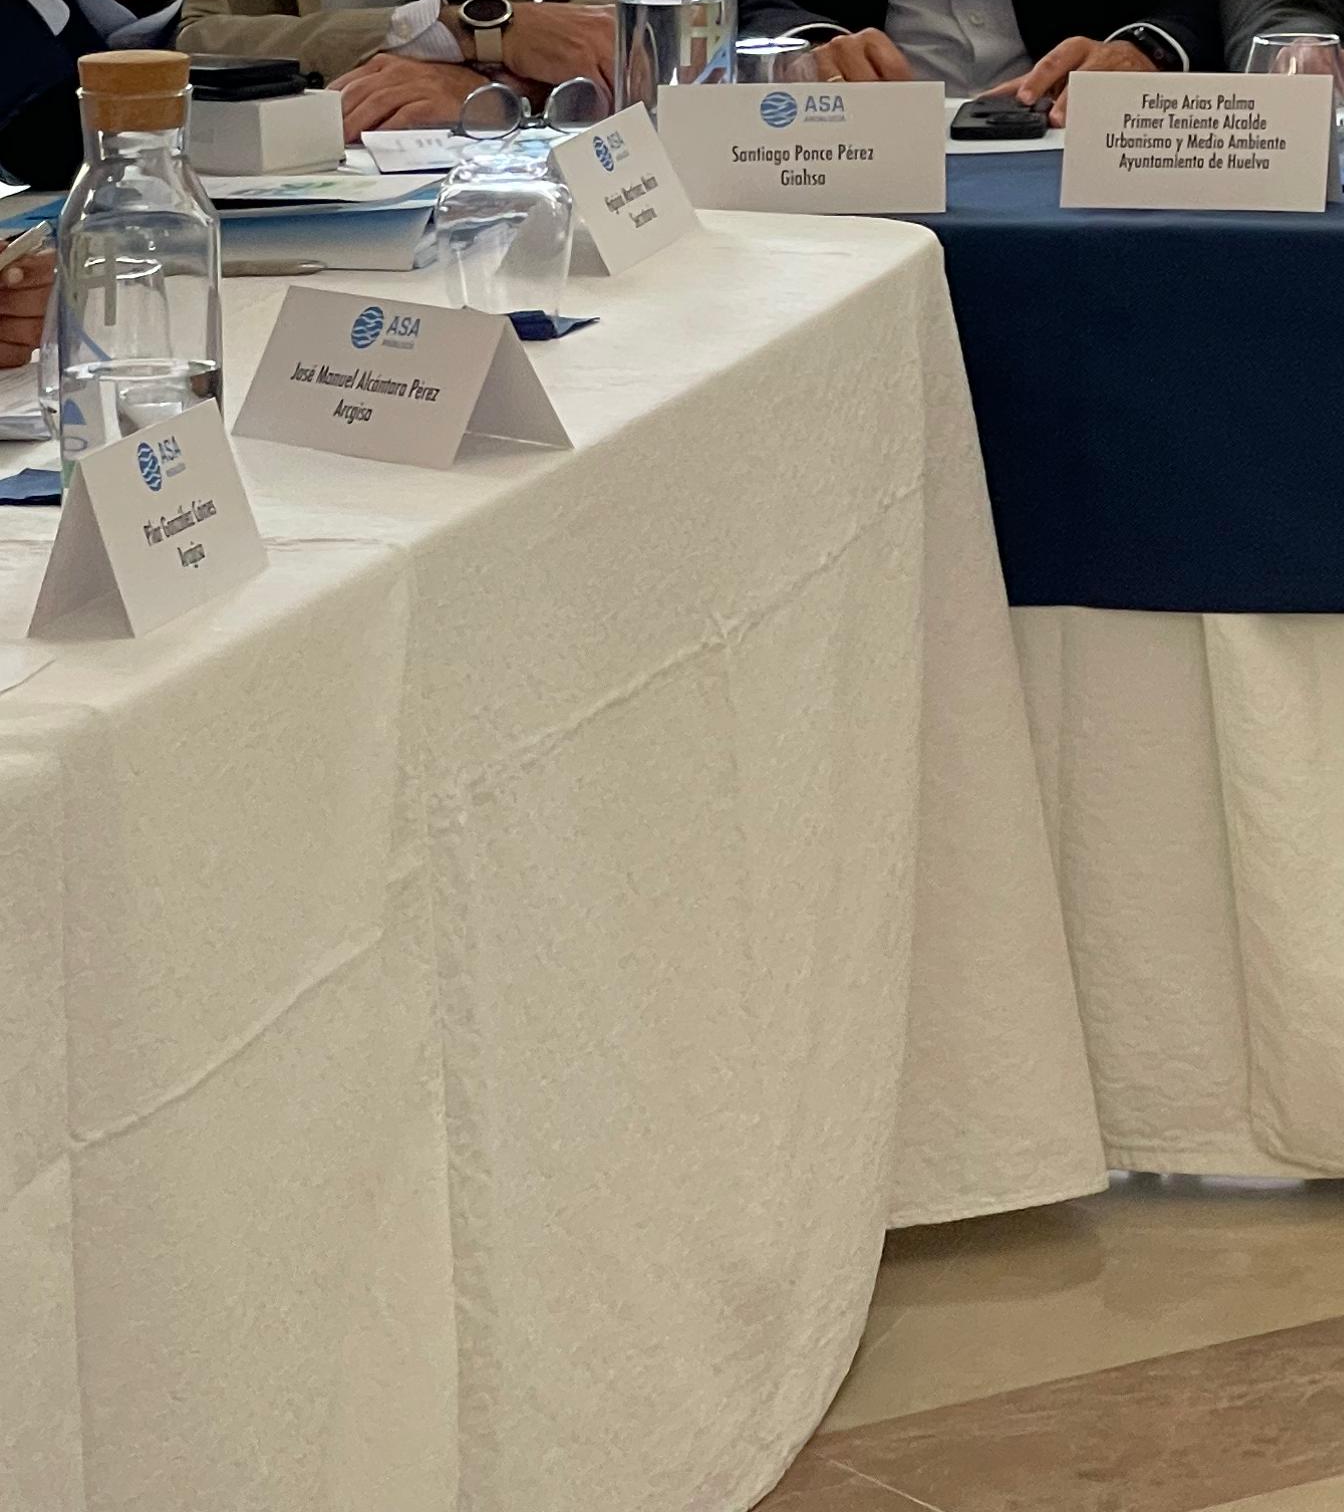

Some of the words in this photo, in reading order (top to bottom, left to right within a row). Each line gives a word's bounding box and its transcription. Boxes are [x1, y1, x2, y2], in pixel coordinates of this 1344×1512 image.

[805, 96, 845, 112] ASA
[1142, 93, 1178, 113] Felipe
[1182, 95, 1212, 110] Arias
[1217, 93, 1255, 110] Palma
[1124, 113, 1164, 129] Primer
[1169, 114, 1218, 130] Teniente
[1222, 115, 1267, 130] Alcalde
[1106, 133, 1172, 149] Urbanismo
[1175, 137, 1182, 152] y
[1188, 134, 1224, 149] Medio
[1228, 135, 1286, 150] Ambiente
[732, 145, 790, 165] Santiago
[795, 145, 832, 161] Ponce
[838, 144, 874, 161] Pérez
[1119, 153, 1204, 170] Ayuntamiento
[1208, 154, 1223, 169] de
[1228, 155, 1269, 170] Huelva
[781, 169, 826, 186] Giahsa
[386, 316, 421, 337] ASA
[291, 362, 317, 383] José
[316, 365, 359, 389] Manuel
[408, 379, 440, 401] Pérez
